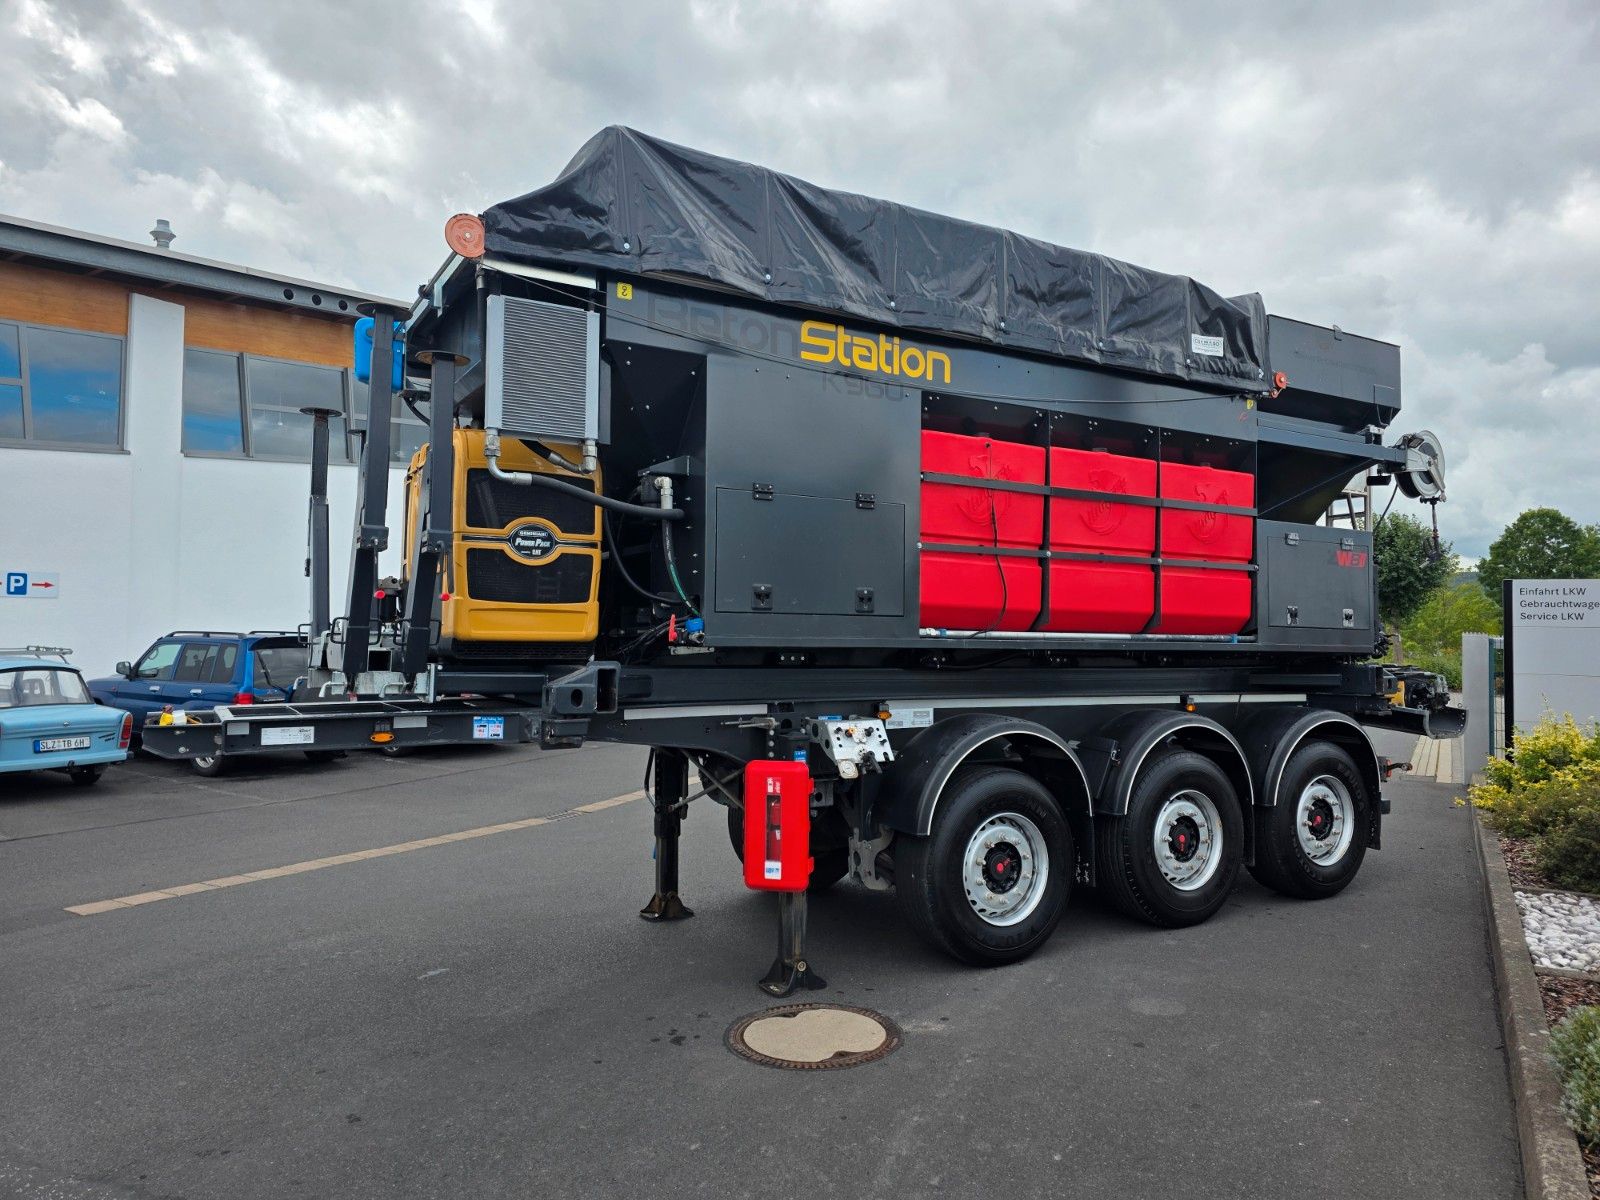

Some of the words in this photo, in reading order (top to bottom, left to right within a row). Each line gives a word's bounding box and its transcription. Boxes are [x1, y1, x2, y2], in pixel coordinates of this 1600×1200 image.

[10, 575, 25, 592] P
[1519, 587, 1560, 596] Einfahrt
[1562, 587, 1587, 596] LKW
[1520, 612, 1558, 621] Service
[1561, 612, 1585, 621] LKW
[40, 740, 57, 750] SLZ
[62, 739, 72, 749] TB
[74, 738, 85, 748] 6H
